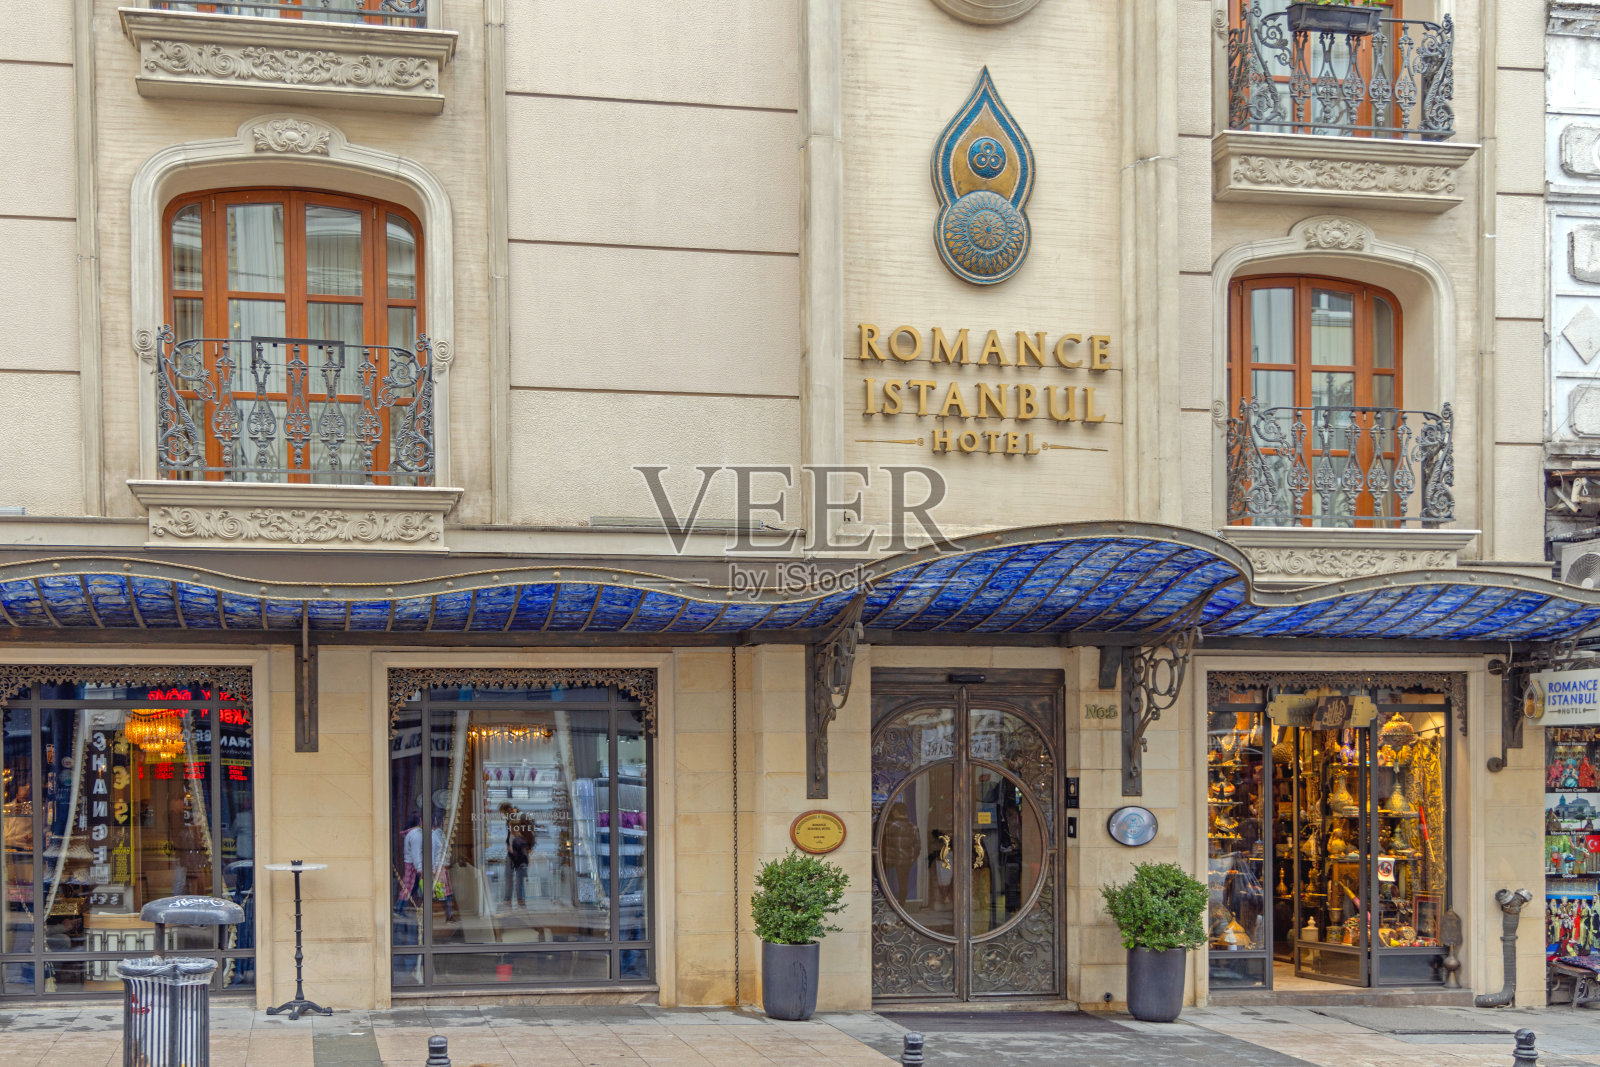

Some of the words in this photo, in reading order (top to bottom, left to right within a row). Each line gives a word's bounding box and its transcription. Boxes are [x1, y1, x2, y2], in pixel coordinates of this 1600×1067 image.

[858, 323, 1112, 370] ROMANCE
[863, 378, 1106, 423] ISTANBUL
[932, 429, 1040, 455] HOTEL
[1548, 679, 1598, 693] ROMANCE
[1548, 693, 1597, 705] ISTANBUL
